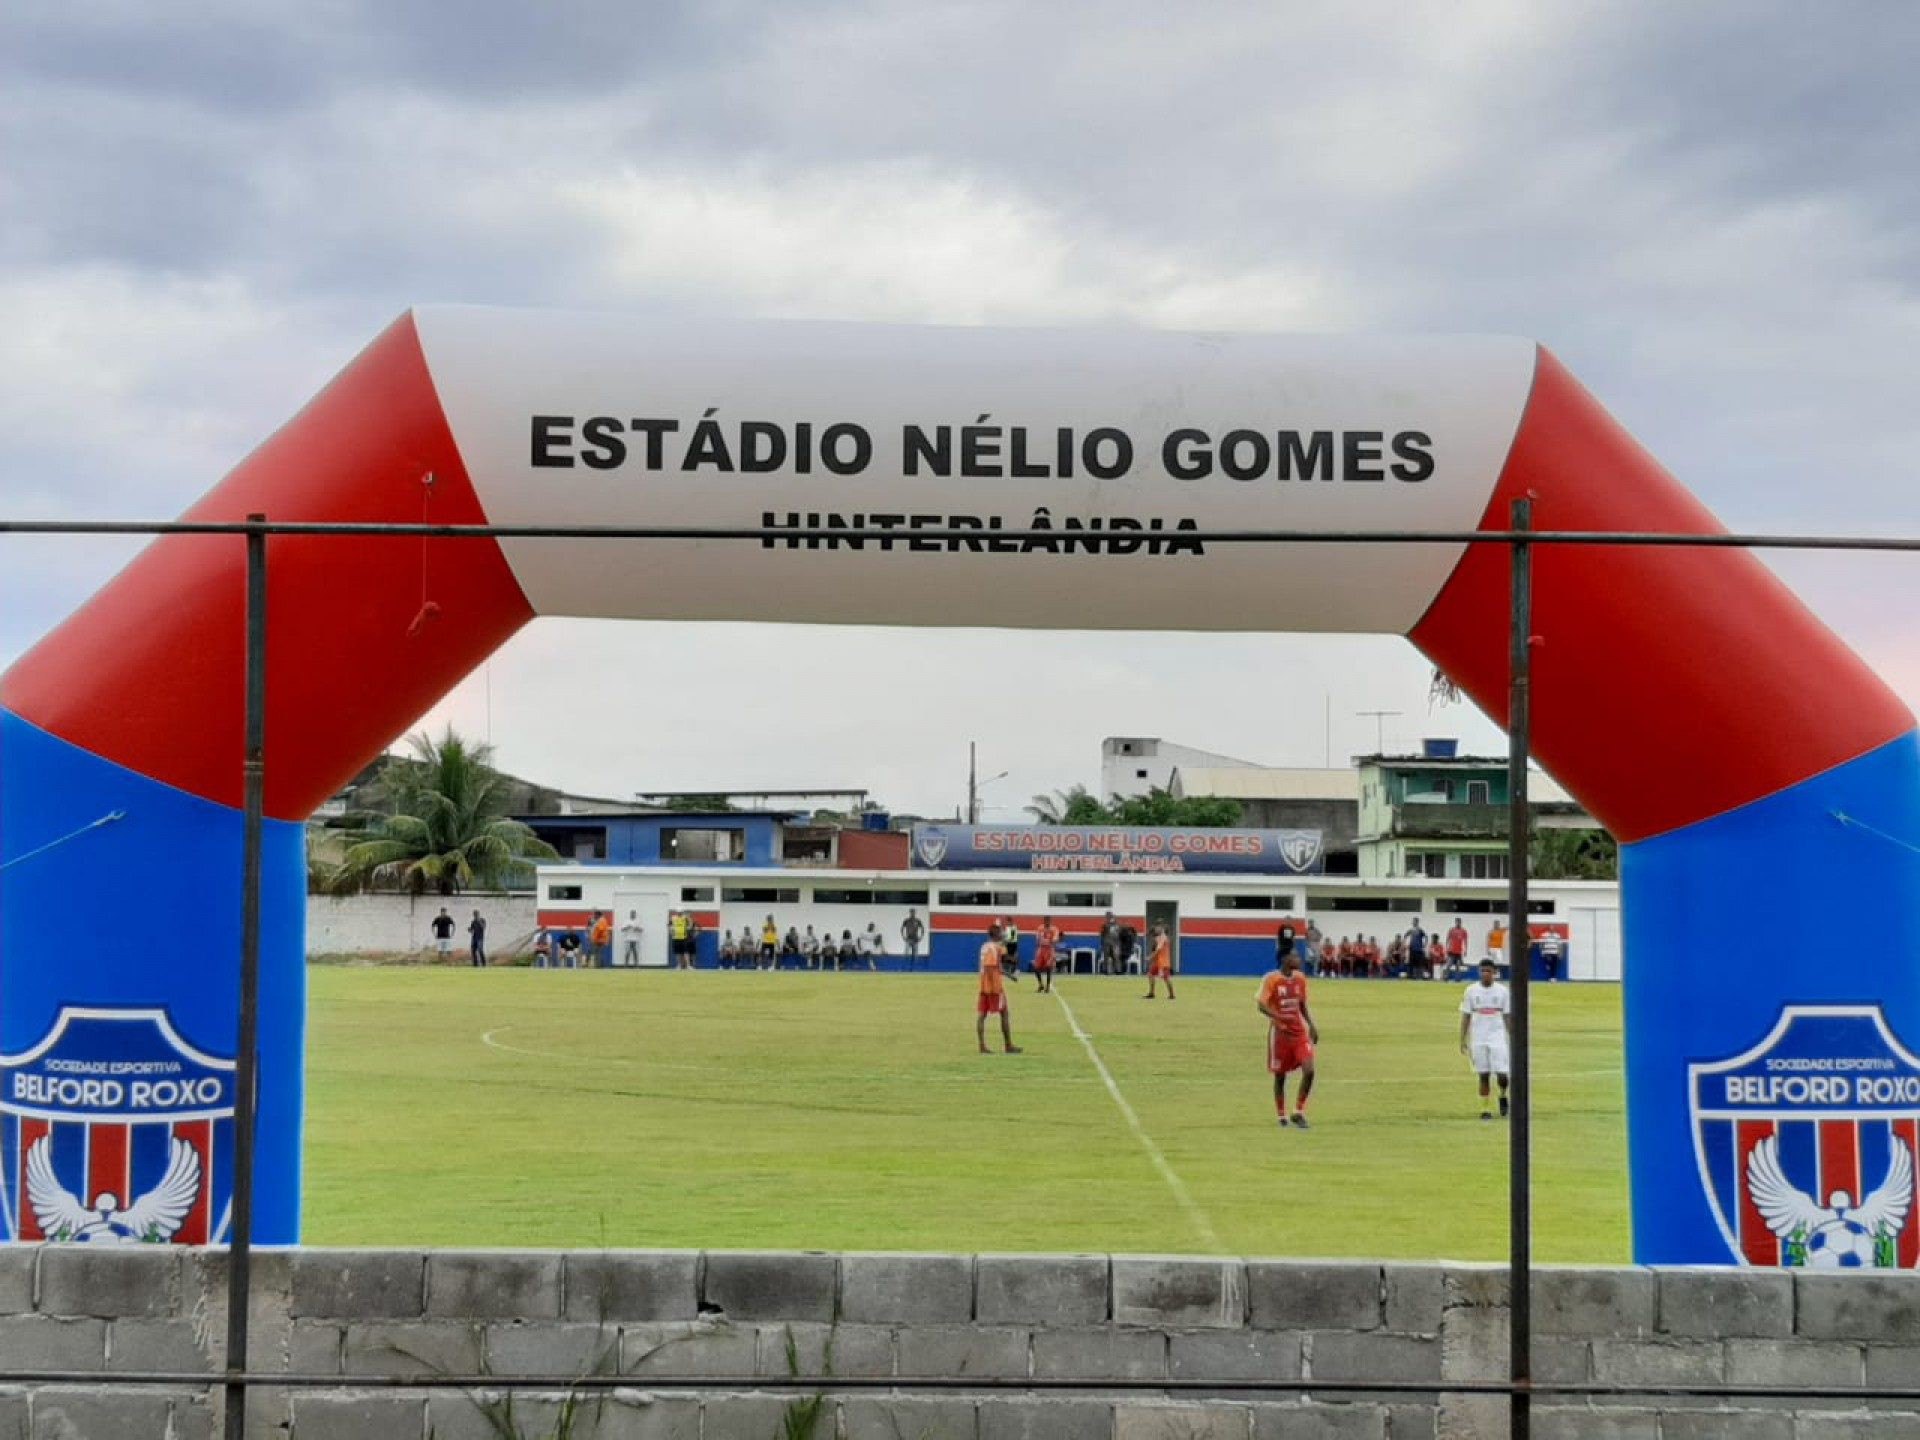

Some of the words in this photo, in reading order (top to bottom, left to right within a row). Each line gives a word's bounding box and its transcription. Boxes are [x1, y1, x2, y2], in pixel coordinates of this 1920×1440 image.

[531, 407, 873, 475] ESTÁDIO
[903, 413, 1133, 480] NÉLIO
[1162, 428, 1435, 483] GOMES
[761, 506, 1205, 556] HINTERLÂNDIA
[1169, 833, 1262, 854] GOMES
[1032, 851, 1184, 872] HINTERLÂNDIA
[45, 1059, 109, 1073] SOCIEDADE
[109, 1061, 182, 1075] ESPORTIVA
[1766, 1058, 1832, 1071] SOCIEDADE
[1834, 1058, 1895, 1071] ESPORTIVA
[14, 1073, 123, 1107] BELFORD
[131, 1077, 222, 1107] ROXO
[1725, 1076, 1849, 1104] BELFORD
[1856, 1076, 1920, 1104] ROXO
